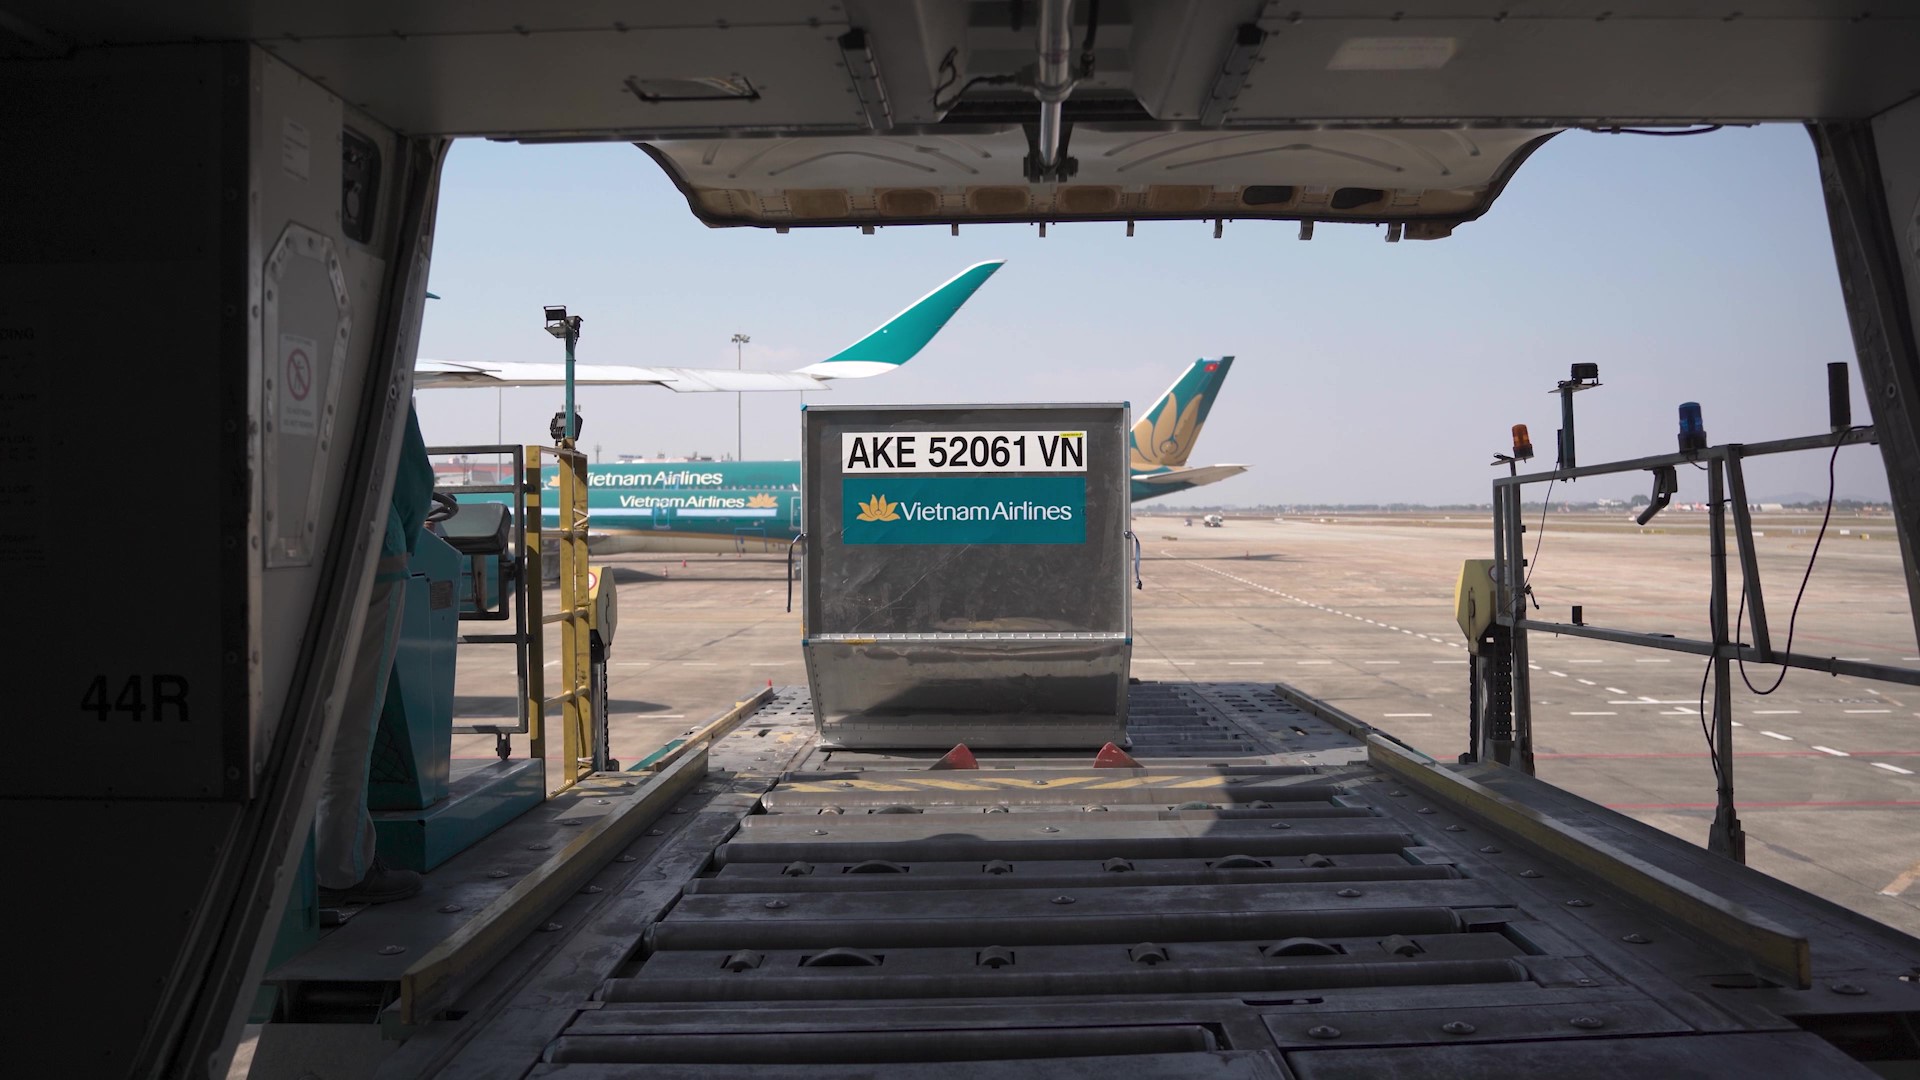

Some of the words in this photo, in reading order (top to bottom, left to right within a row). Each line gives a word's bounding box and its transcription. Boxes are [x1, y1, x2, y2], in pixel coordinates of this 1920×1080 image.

[848, 436, 916, 469] AKE
[928, 435, 1026, 467] 52061
[1038, 435, 1084, 467] VN
[653, 470, 723, 486] Airlines
[619, 495, 685, 508] Vietnam
[685, 495, 745, 508] Airlines
[900, 502, 990, 521] Vietnam
[991, 501, 1073, 521] Airlines
[81, 674, 189, 721] 44R
